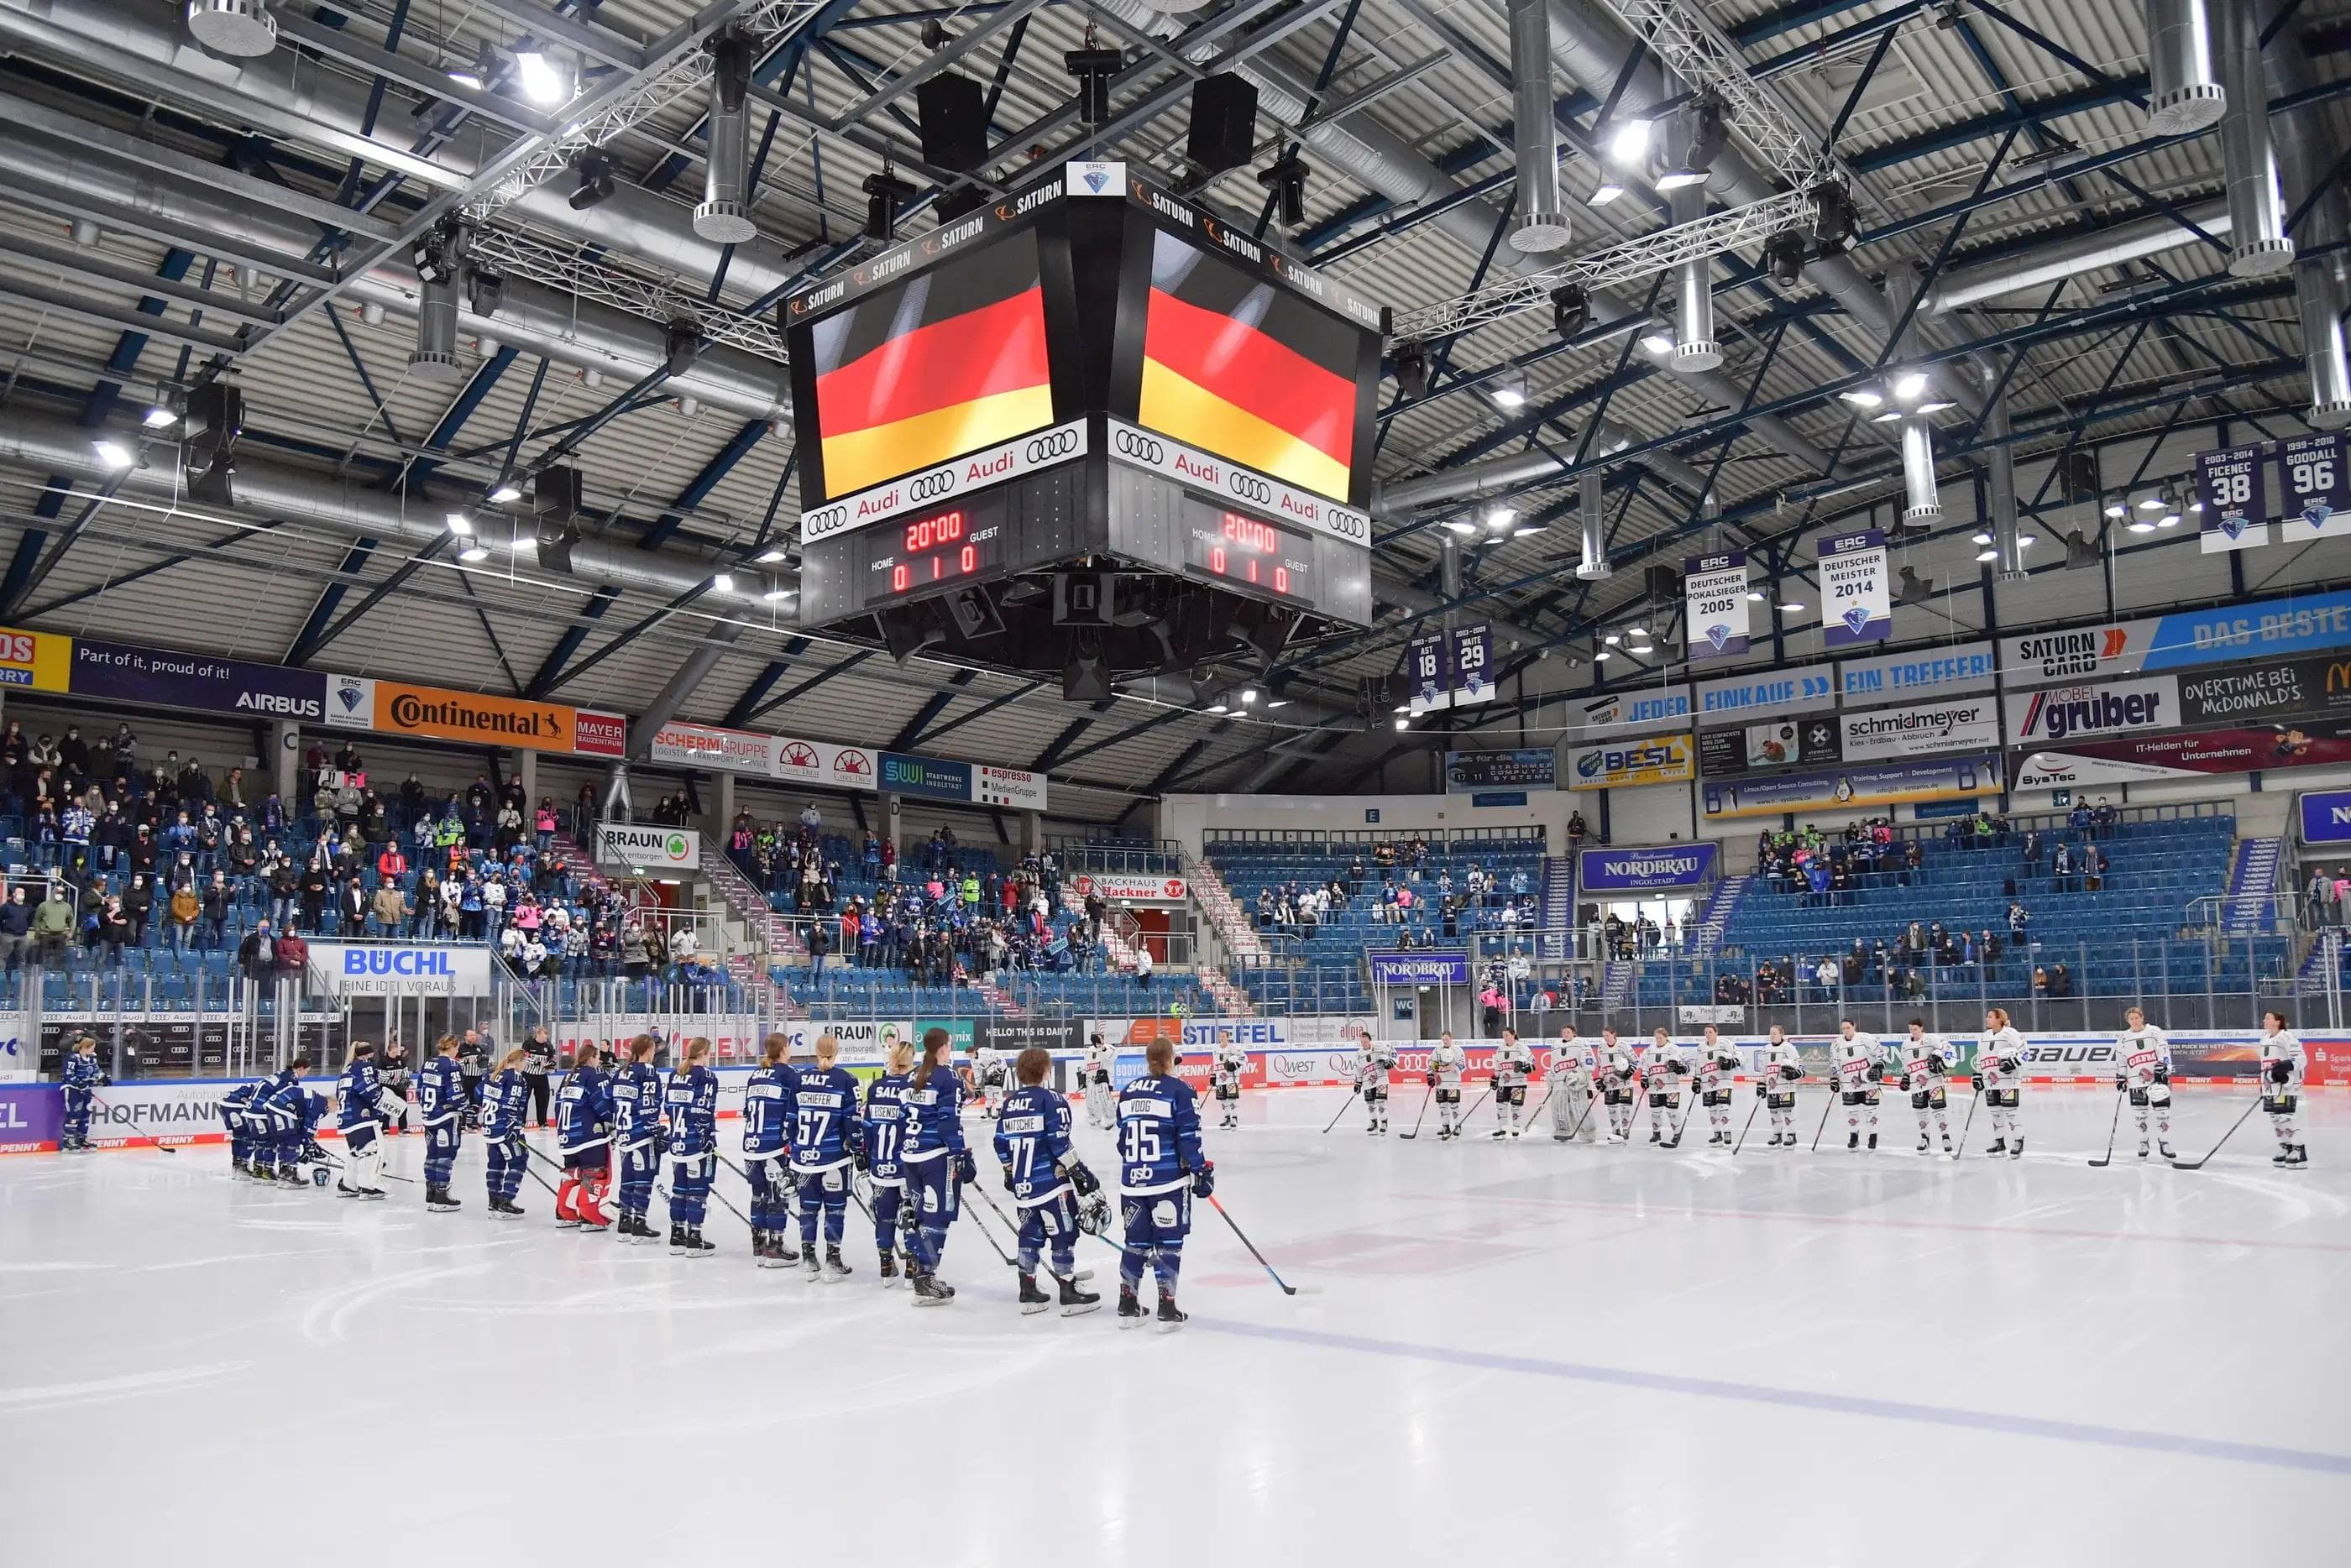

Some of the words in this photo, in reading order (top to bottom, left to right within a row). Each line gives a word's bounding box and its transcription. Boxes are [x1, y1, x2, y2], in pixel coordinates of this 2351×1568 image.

[1017, 180, 1062, 215] SATURN
[1152, 192, 1193, 227] SATURN
[941, 216, 983, 249] SATURN
[1223, 231, 1260, 264] SATURN
[872, 250, 910, 281] SATURN
[1287, 265, 1322, 296] SATURN
[809, 281, 844, 311] SATURN
[1347, 298, 1380, 327] SATURN
[2286, 448, 2338, 466] GOODALL
[966, 451, 1014, 483] Audi
[1175, 453, 1219, 484] Audi
[2207, 462, 2251, 478] FICENEC
[2293, 461, 2334, 494] 96
[2212, 474, 2250, 506] 38
[857, 489, 899, 518] Audi
[1281, 493, 1318, 521] Audi
[970, 526, 998, 542] GUEST
[1192, 527, 1216, 542] HOME
[1835, 536, 1866, 549] ERC
[872, 557, 894, 572] HOME
[894, 565, 907, 591] 0
[934, 557, 940, 579] 1
[961, 546, 974, 572] 0
[1214, 547, 1225, 573] 0
[1249, 560, 1256, 582] 1
[1275, 567, 1287, 593] 0
[1285, 558, 1308, 573] GUEST
[1700, 556, 1729, 567] ERC
[1825, 554, 1881, 572] DEUTSCHER
[1690, 574, 1741, 589] DEUTSCHER
[1830, 567, 1876, 582] MEISTER
[1688, 585, 1746, 600] POKALSIEGER
[1835, 580, 1873, 598] 2014
[1700, 598, 1734, 614] 2005
[2194, 619, 2250, 650] DAS
[2261, 605, 2351, 642] BESTE
[1461, 635, 1481, 647] WAITE
[2020, 632, 2095, 661] SATURN
[1421, 645, 1433, 656] AST
[1461, 645, 1484, 670] 29
[80, 648, 111, 665] Part
[114, 654, 131, 666] of
[134, 656, 147, 671] it,
[152, 661, 194, 677] proud
[198, 664, 213, 678] of
[216, 666, 230, 680] it!
[1419, 655, 1437, 677] 18
[2043, 652, 2097, 677] CARD
[341, 677, 361, 687] ERC
[1846, 669, 1882, 695] EIN
[1893, 653, 1992, 687] TREFFER!
[1705, 680, 1793, 711] EINKAUF
[2048, 686, 2098, 703] MÖBEL
[235, 692, 320, 717] AIRBUS
[1629, 696, 1688, 722] JEDER
[390, 693, 539, 736] Continental
[1849, 708, 1979, 736] schmidmeyer
[2045, 690, 2159, 739] gruber
[577, 720, 623, 739] MAYER
[1902, 732, 1935, 740] Abbruch
[283, 731, 297, 750] C
[577, 735, 623, 747] BAUZENTRUM
[2135, 741, 2181, 753] IT-Helden
[2183, 739, 2199, 750] für
[1605, 746, 1685, 771] BESL
[2181, 747, 2251, 761] Unternehmen
[885, 761, 924, 785] SWI
[926, 772, 962, 783] STADTWERKE
[992, 768, 1032, 783] espresso
[1879, 771, 1903, 781] Support
[1911, 766, 1953, 776] Development
[2022, 772, 2076, 786] SysTec
[926, 780, 962, 790] INGOLSTADT
[992, 782, 1038, 797] MedienGruppe
[891, 802, 900, 815] D
[1369, 811, 1377, 821] E
[606, 830, 662, 849] BRAUN
[627, 851, 662, 860] entsorgen
[1605, 857, 1699, 877] NORDBRÄU
[1102, 877, 1157, 887] BACKHAUS
[1102, 886, 1157, 897] Hackner
[344, 949, 456, 975] BÜCHL
[344, 980, 371, 991] EINE
[406, 980, 456, 992] VORAUS
[1395, 1001, 1413, 1009] WC
[986, 1027, 1015, 1037] HELLO!
[1037, 1027, 1045, 1036] IS
[1183, 1024, 1285, 1045] STIEFEL
[361, 1066, 374, 1076] 33
[176, 1090, 230, 1100] Autohaus
[642, 1081, 656, 1094] 23
[704, 1083, 714, 1096] 14
[799, 1094, 832, 1105] SCHIEFER
[1131, 1100, 1151, 1112] VOOG
[746, 1100, 765, 1134] 31
[1004, 1117, 1034, 1132] MITSCHKE
[797, 1110, 830, 1146] 67
[672, 1139, 686, 1153] gsb
[744, 1134, 760, 1150] gsb
[877, 1123, 897, 1161] 11
[903, 1137, 919, 1150] gsb
[1125, 1120, 1160, 1163] 95
[800, 1147, 820, 1163] gsb
[1009, 1137, 1035, 1179] 77
[877, 1161, 898, 1177] gsb
[1129, 1163, 1153, 1184] gsb
[1014, 1179, 1032, 1197] gsb
